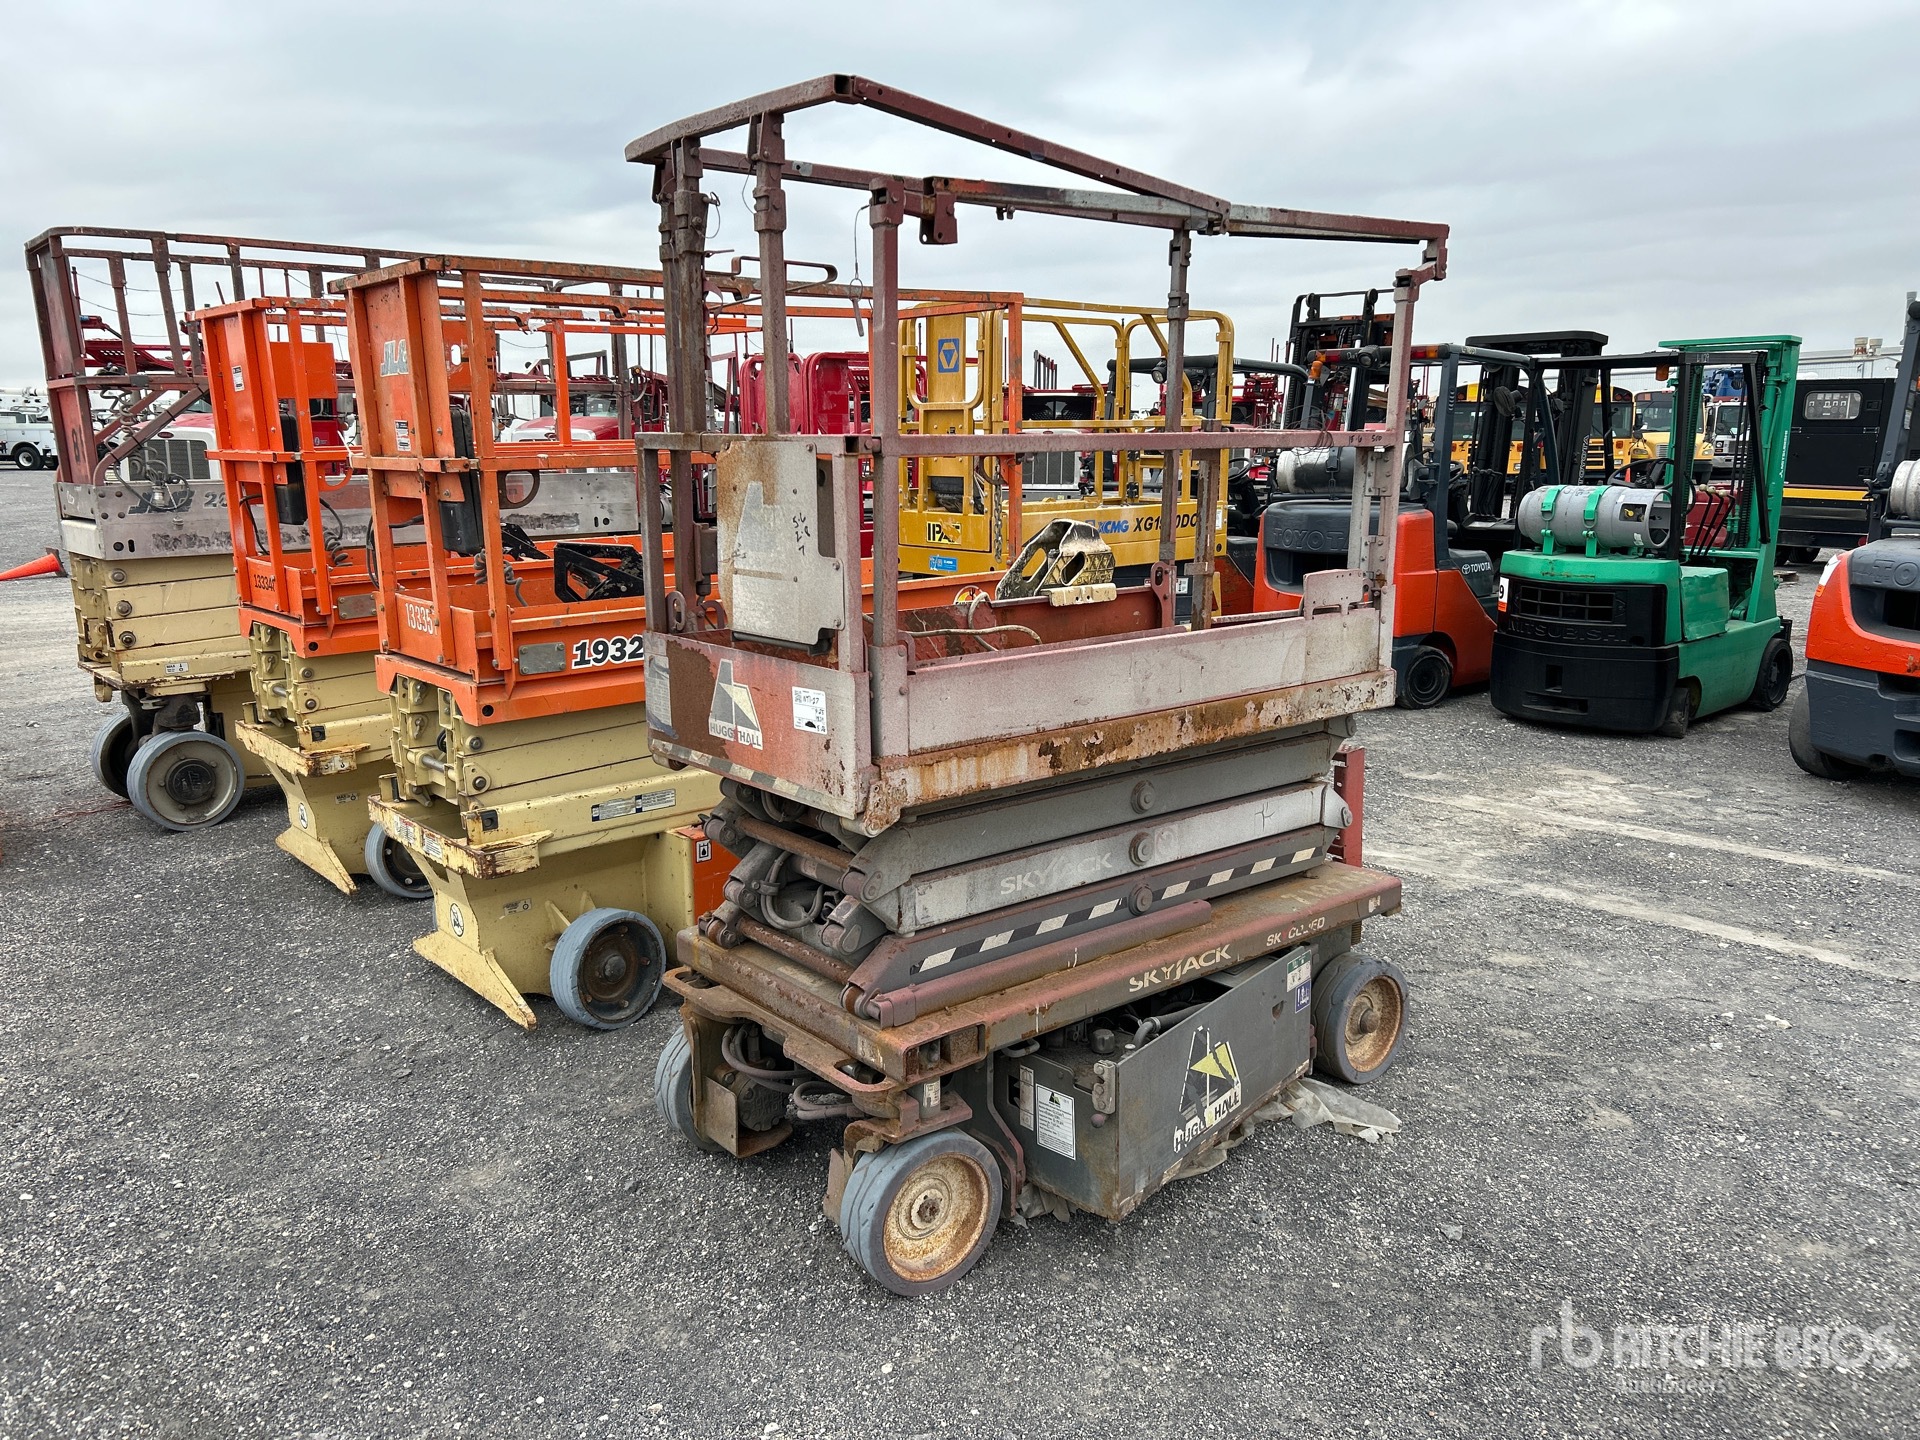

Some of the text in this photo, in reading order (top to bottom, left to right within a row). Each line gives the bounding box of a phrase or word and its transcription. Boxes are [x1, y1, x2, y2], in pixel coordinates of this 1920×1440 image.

[1471, 561, 1492, 573] TOYOTA
[710, 722, 734, 738] HUGG
[1129, 943, 1232, 993] SKYJACK
